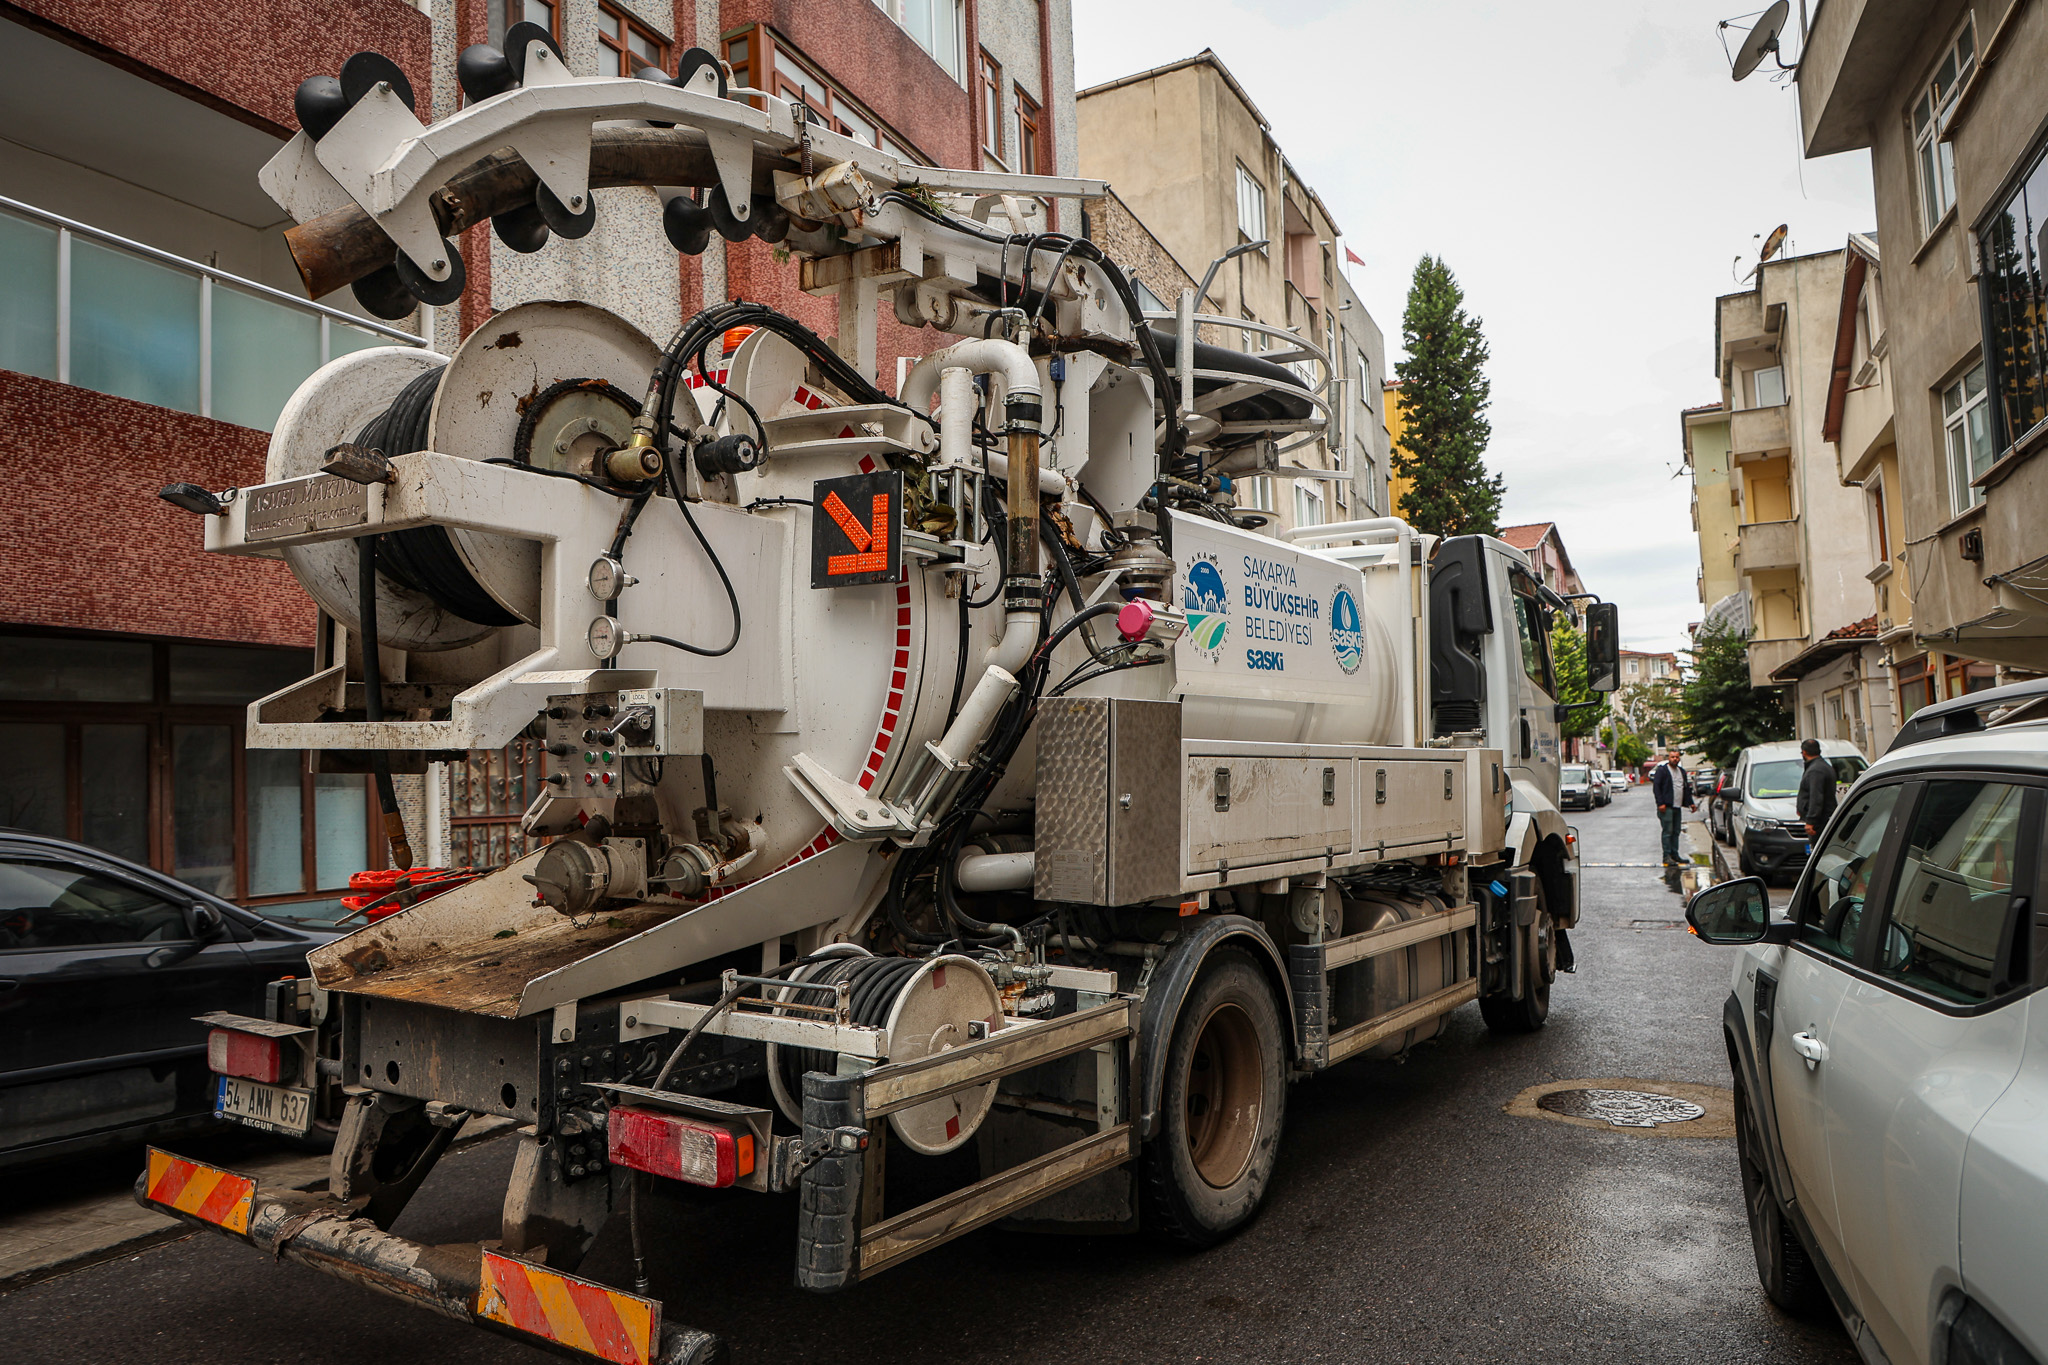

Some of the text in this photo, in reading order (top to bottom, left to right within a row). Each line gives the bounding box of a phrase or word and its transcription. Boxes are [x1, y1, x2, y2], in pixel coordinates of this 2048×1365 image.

[252, 477, 361, 513] ASMEL MAKINA
[1243, 555, 1297, 588] SAKARYA
[1244, 582, 1319, 619] BÜYÜKŞEHİR
[1246, 615, 1312, 646] BELEDİYESİ
[225, 1081, 307, 1125] 54 ANN 637
